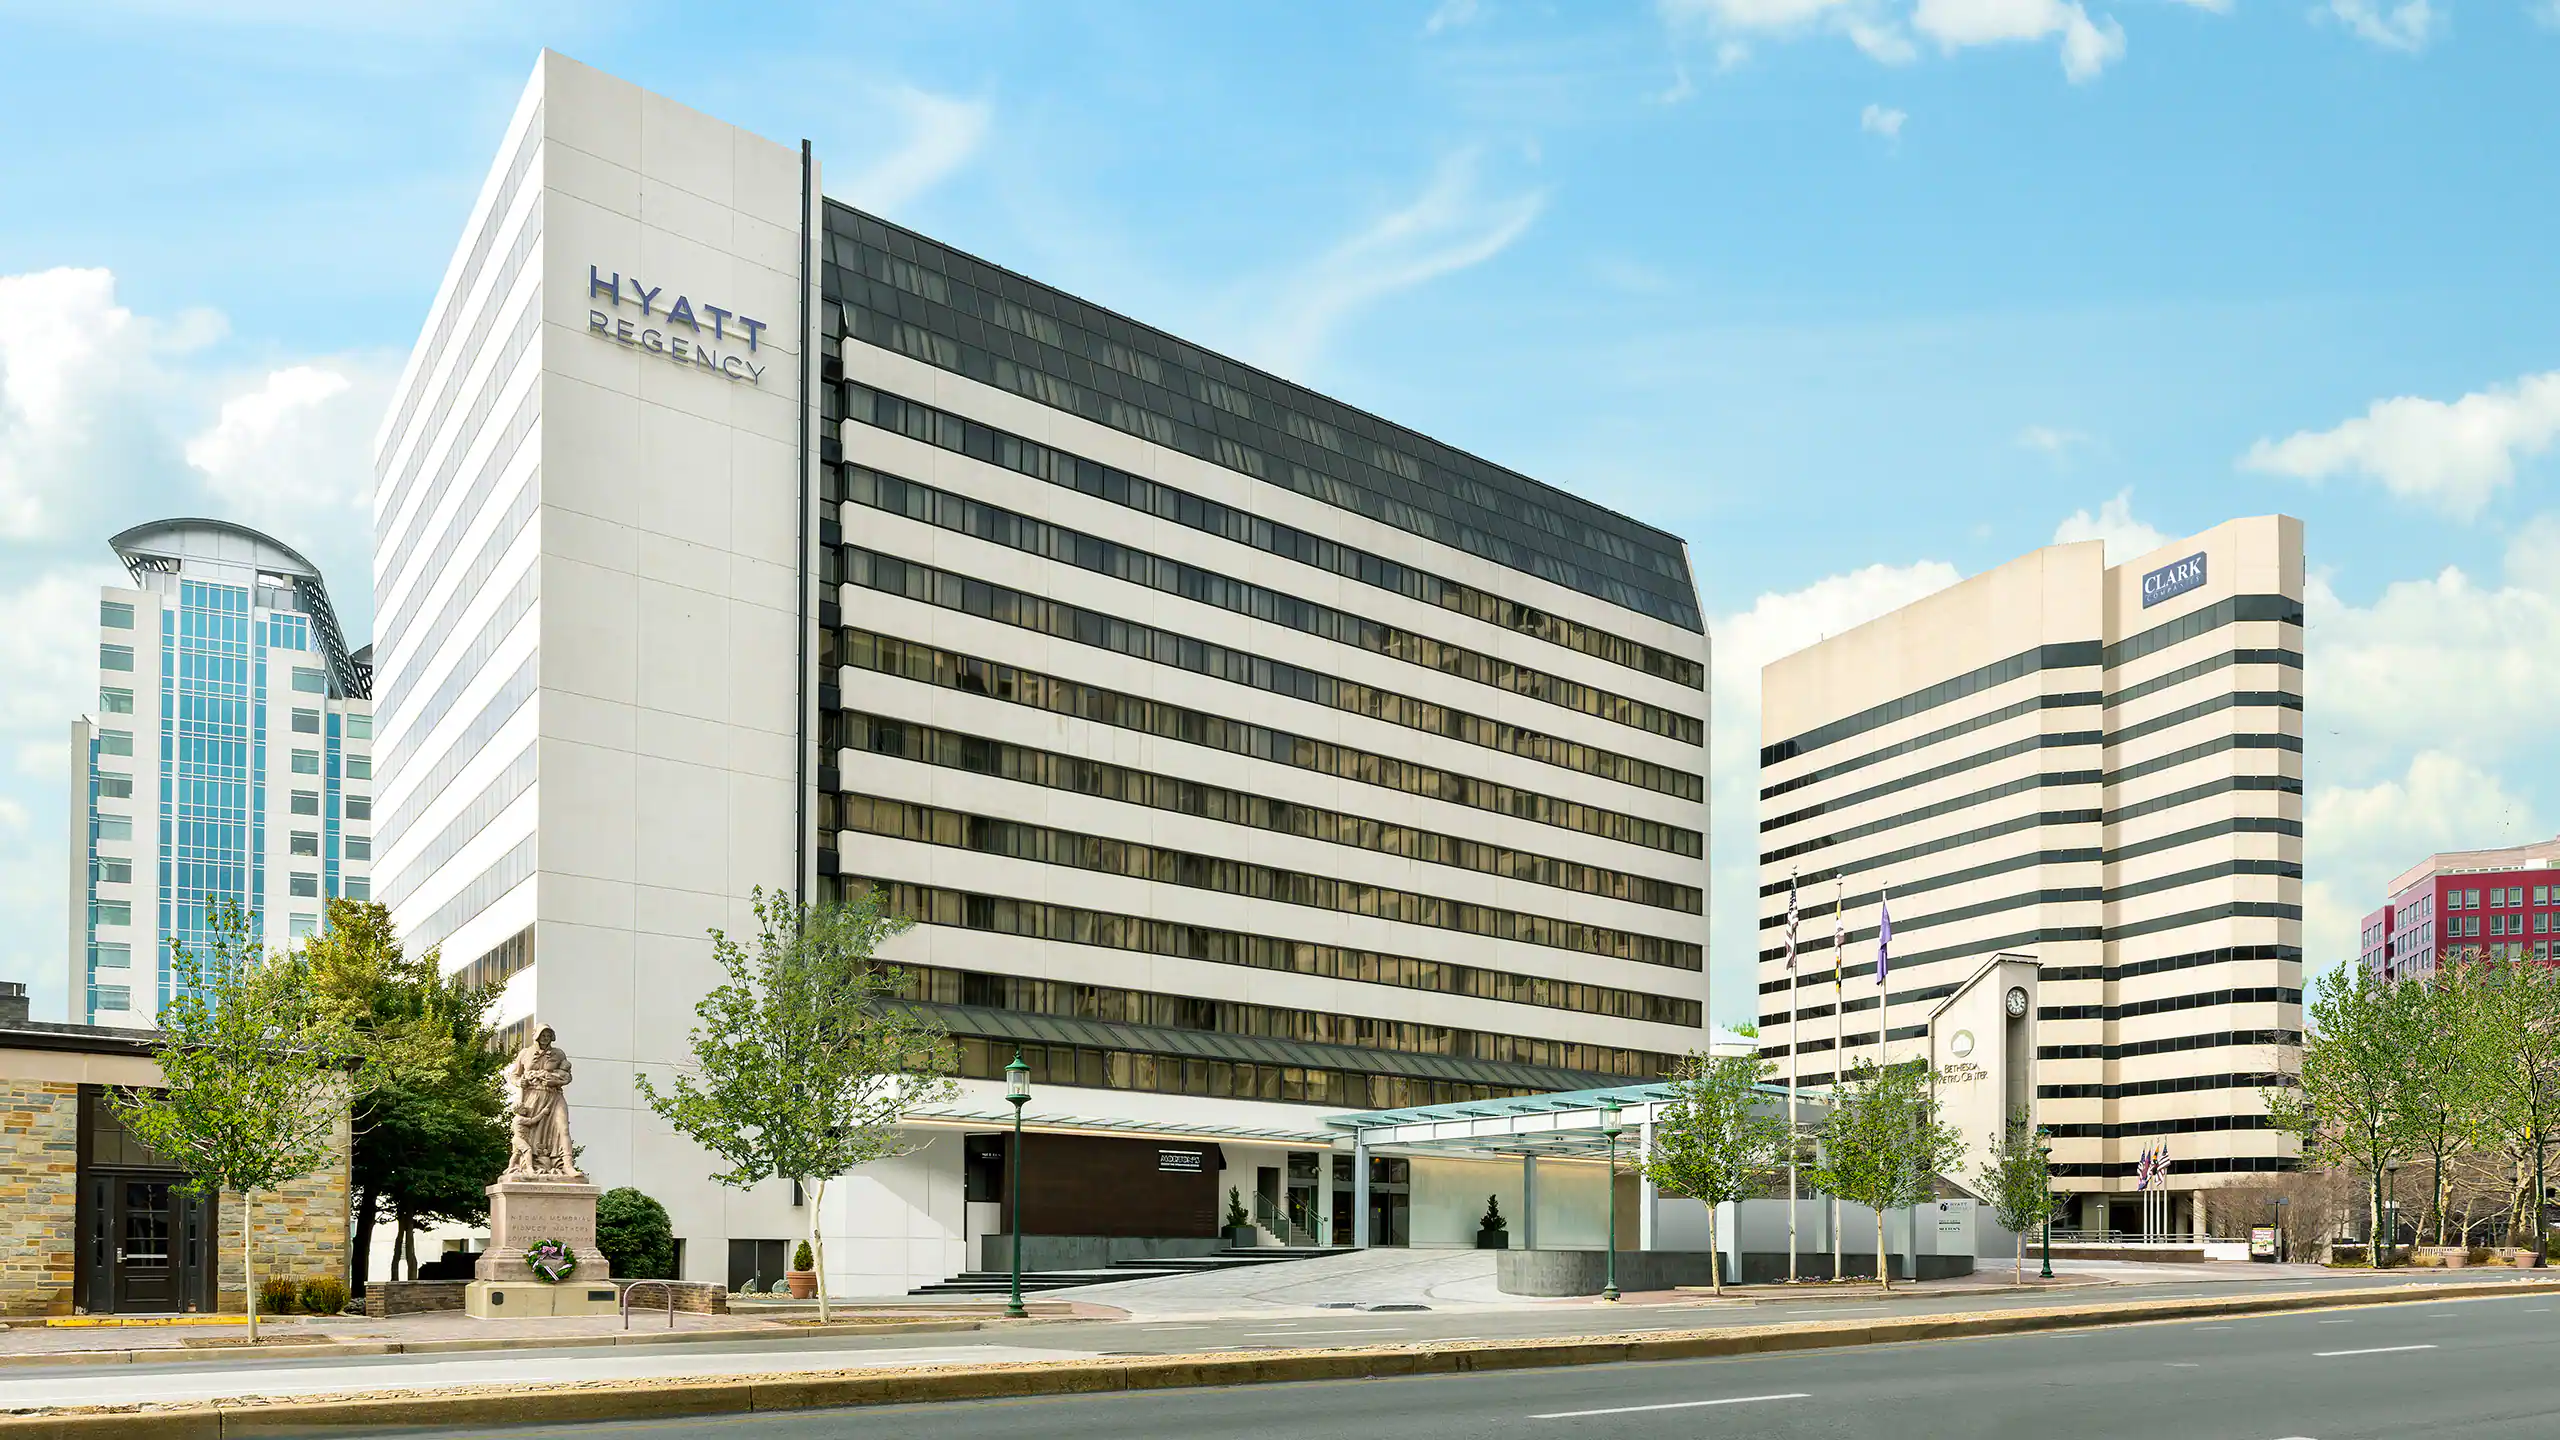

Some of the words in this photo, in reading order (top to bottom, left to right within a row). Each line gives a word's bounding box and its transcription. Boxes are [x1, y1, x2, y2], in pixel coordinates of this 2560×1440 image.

[590, 264, 767, 353] HYATT
[590, 309, 766, 385] REGENCY
[2144, 557, 2202, 594] CLARK
[1944, 1062, 1980, 1074] BETHESDA
